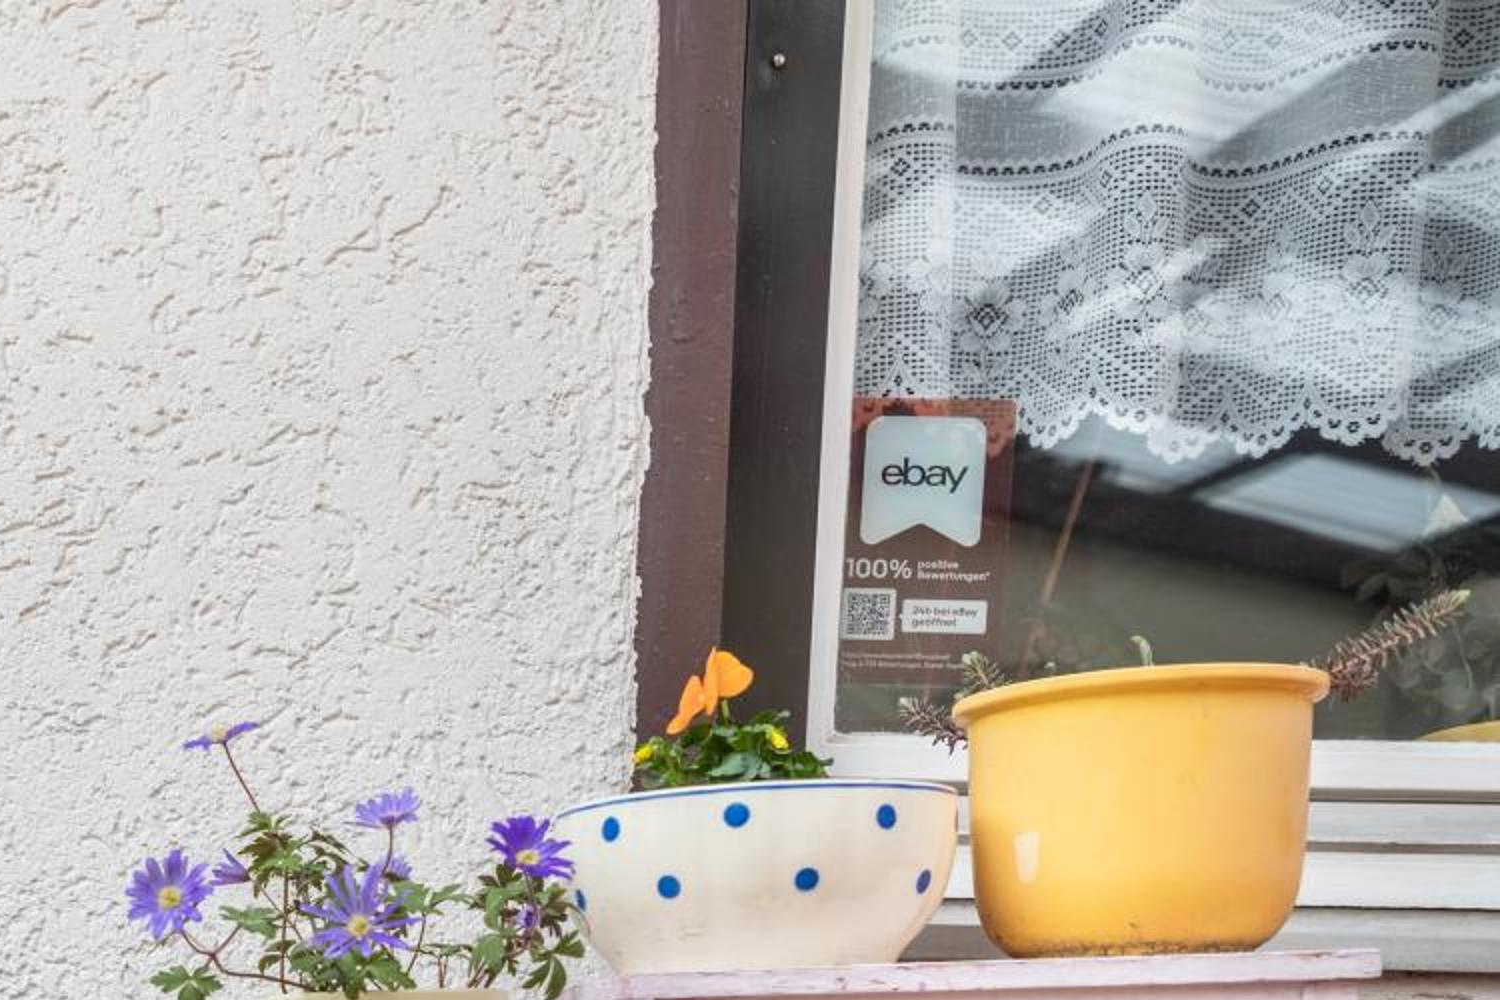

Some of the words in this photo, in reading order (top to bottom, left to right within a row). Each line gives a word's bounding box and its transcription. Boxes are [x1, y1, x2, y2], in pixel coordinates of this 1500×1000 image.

[881, 457, 968, 493] ebay
[846, 558, 912, 579] 100%
[917, 560, 959, 570] positive
